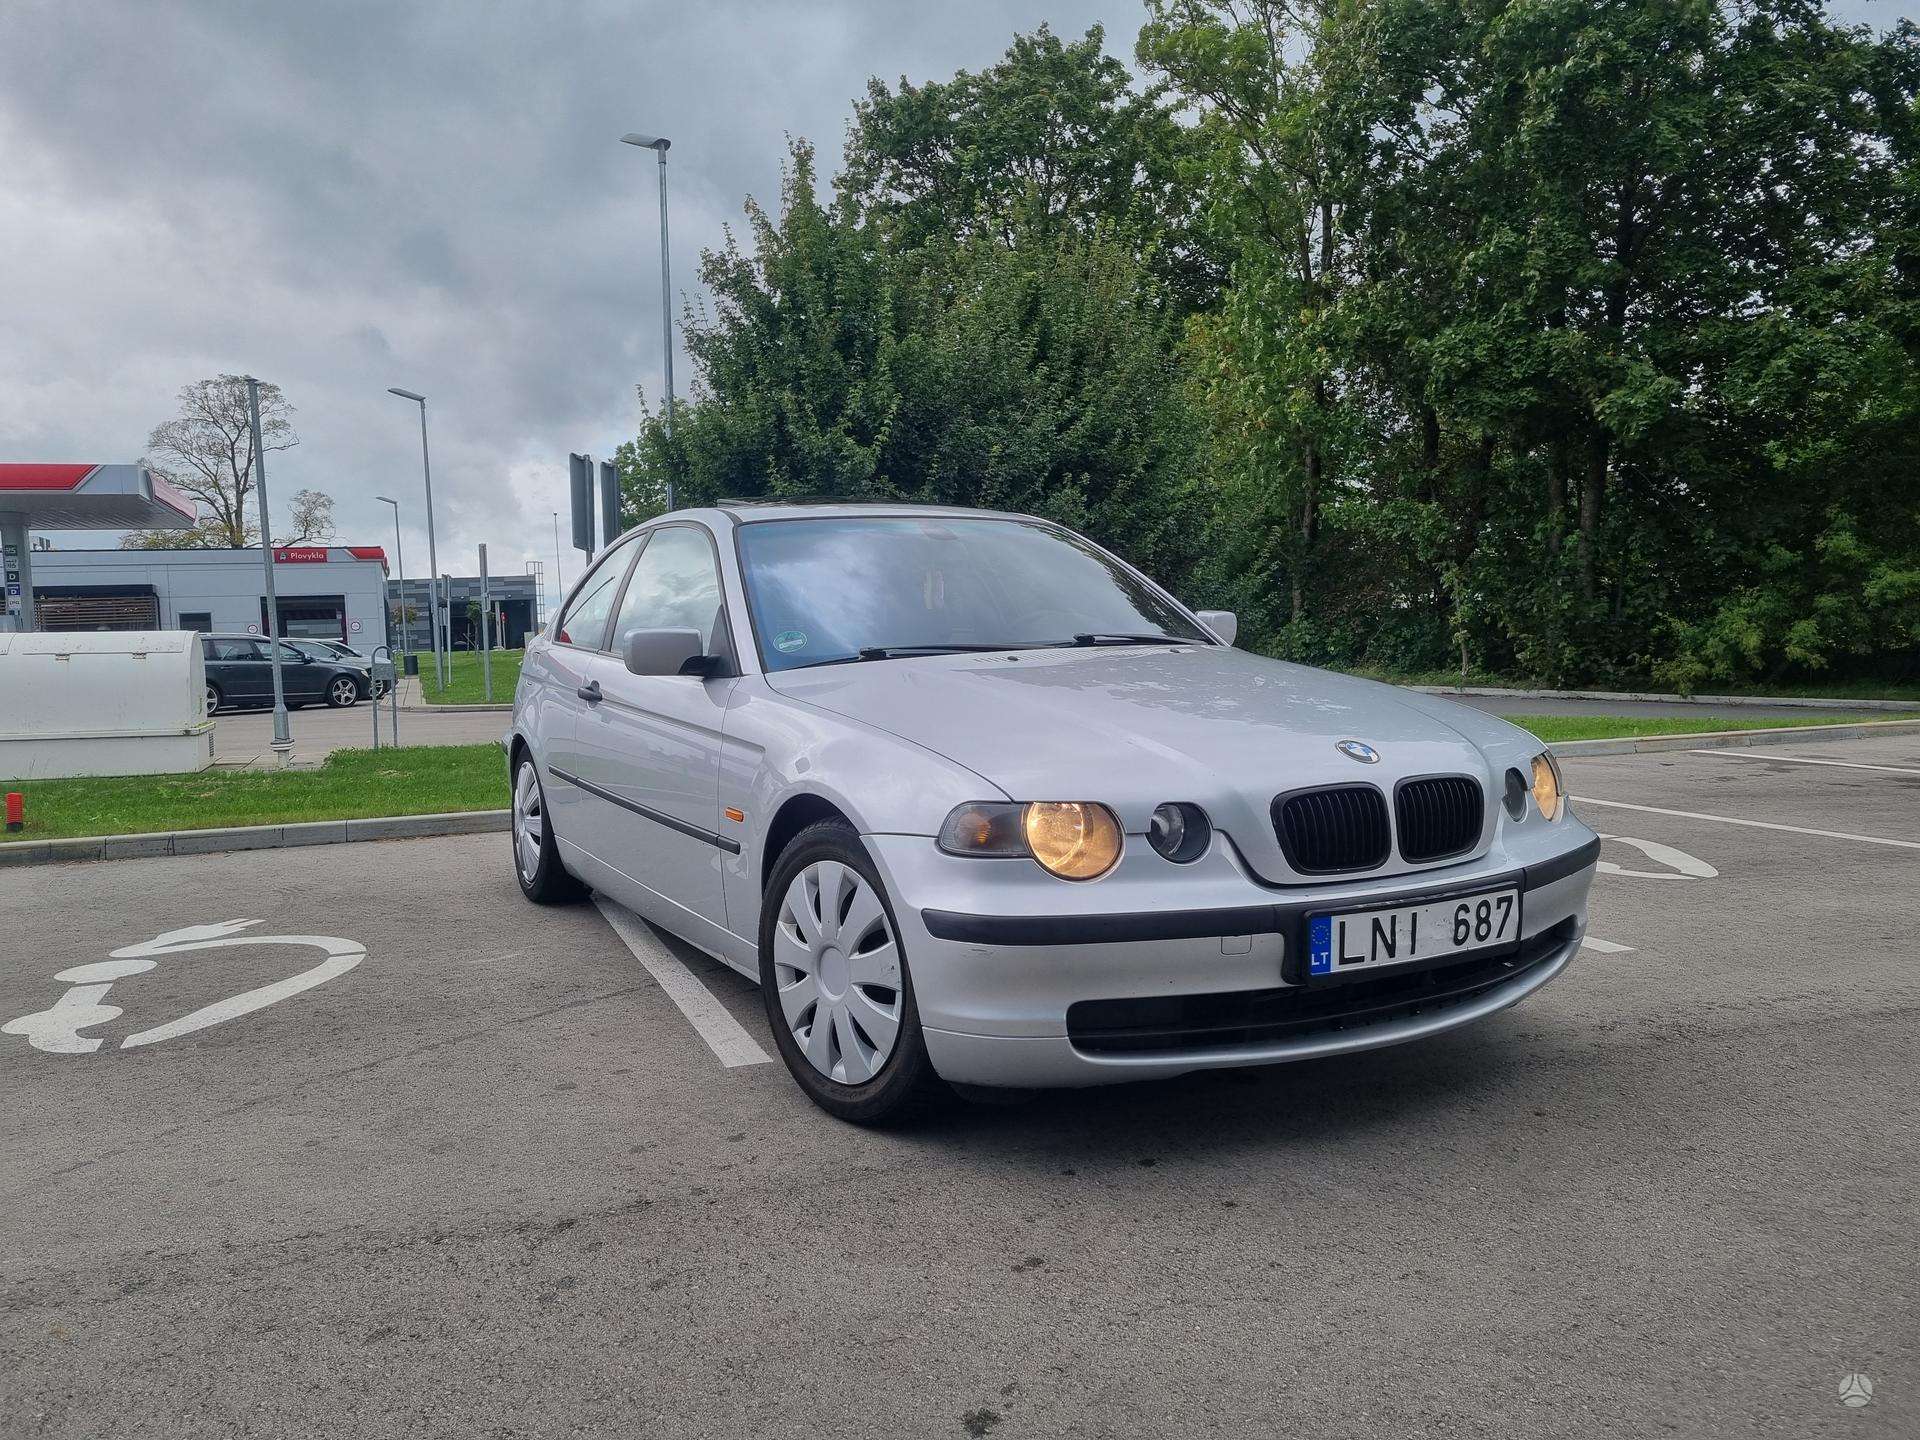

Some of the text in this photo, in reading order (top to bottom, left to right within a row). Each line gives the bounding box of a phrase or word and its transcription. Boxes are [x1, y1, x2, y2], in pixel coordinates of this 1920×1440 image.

[290, 552, 324, 560] Plovykla
[1338, 894, 1514, 965] LNI 687
[1311, 951, 1329, 966] LT
